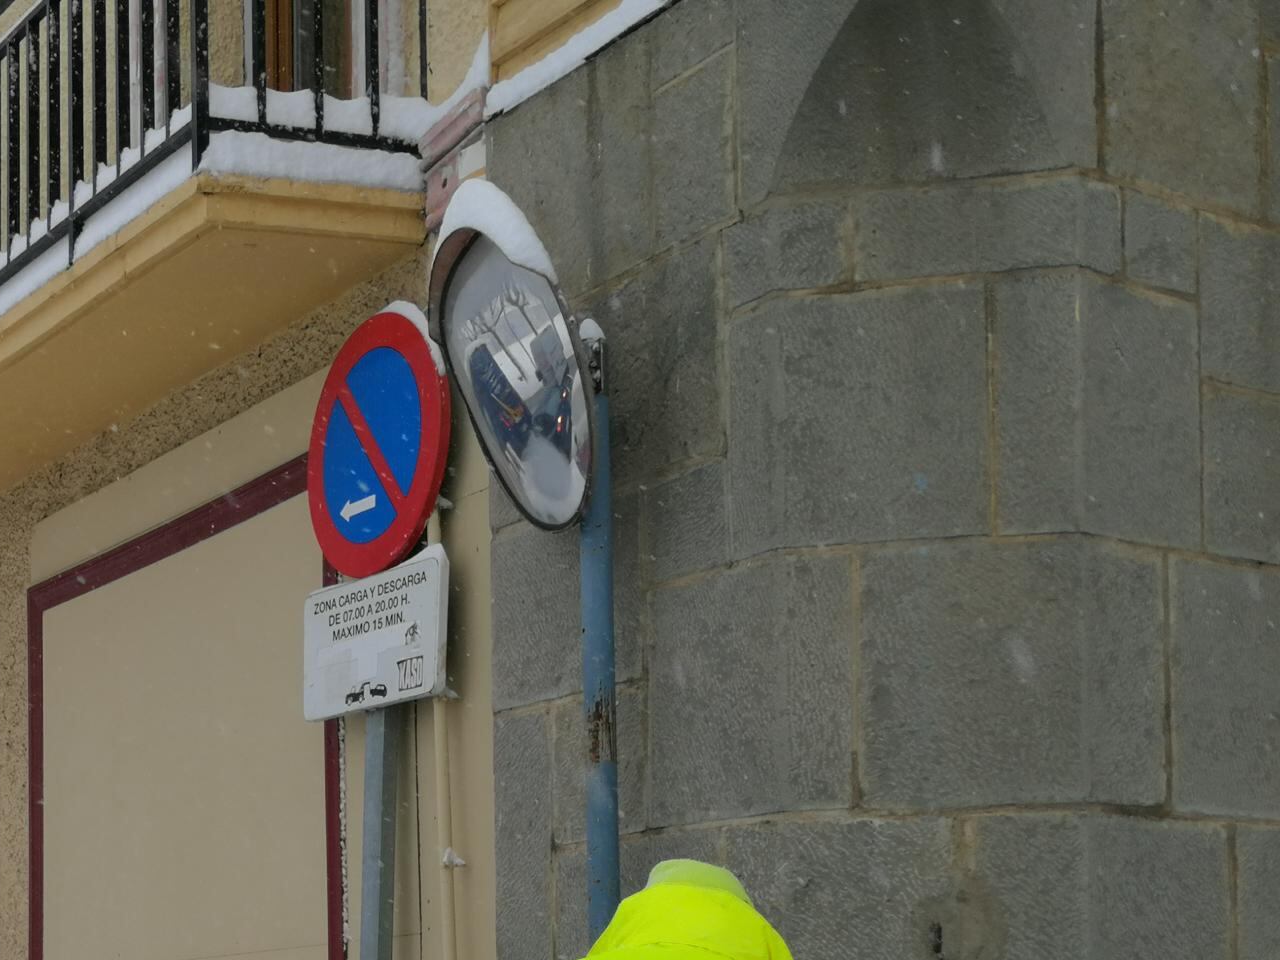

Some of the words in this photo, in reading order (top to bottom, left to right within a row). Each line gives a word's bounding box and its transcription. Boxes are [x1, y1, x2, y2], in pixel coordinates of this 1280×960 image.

[314, 599, 337, 615] ZONA
[338, 590, 368, 607] CARGA
[370, 586, 375, 598] Y
[377, 572, 427, 596] DESCARGA
[329, 613, 341, 626] DE
[343, 606, 365, 622] 07.00
[367, 604, 373, 616] A
[375, 597, 399, 613] 20.00
[401, 593, 410, 606] H.
[332, 621, 370, 641] MAXIMO
[373, 618, 383, 631] 15
[385, 612, 405, 627] MIN.
